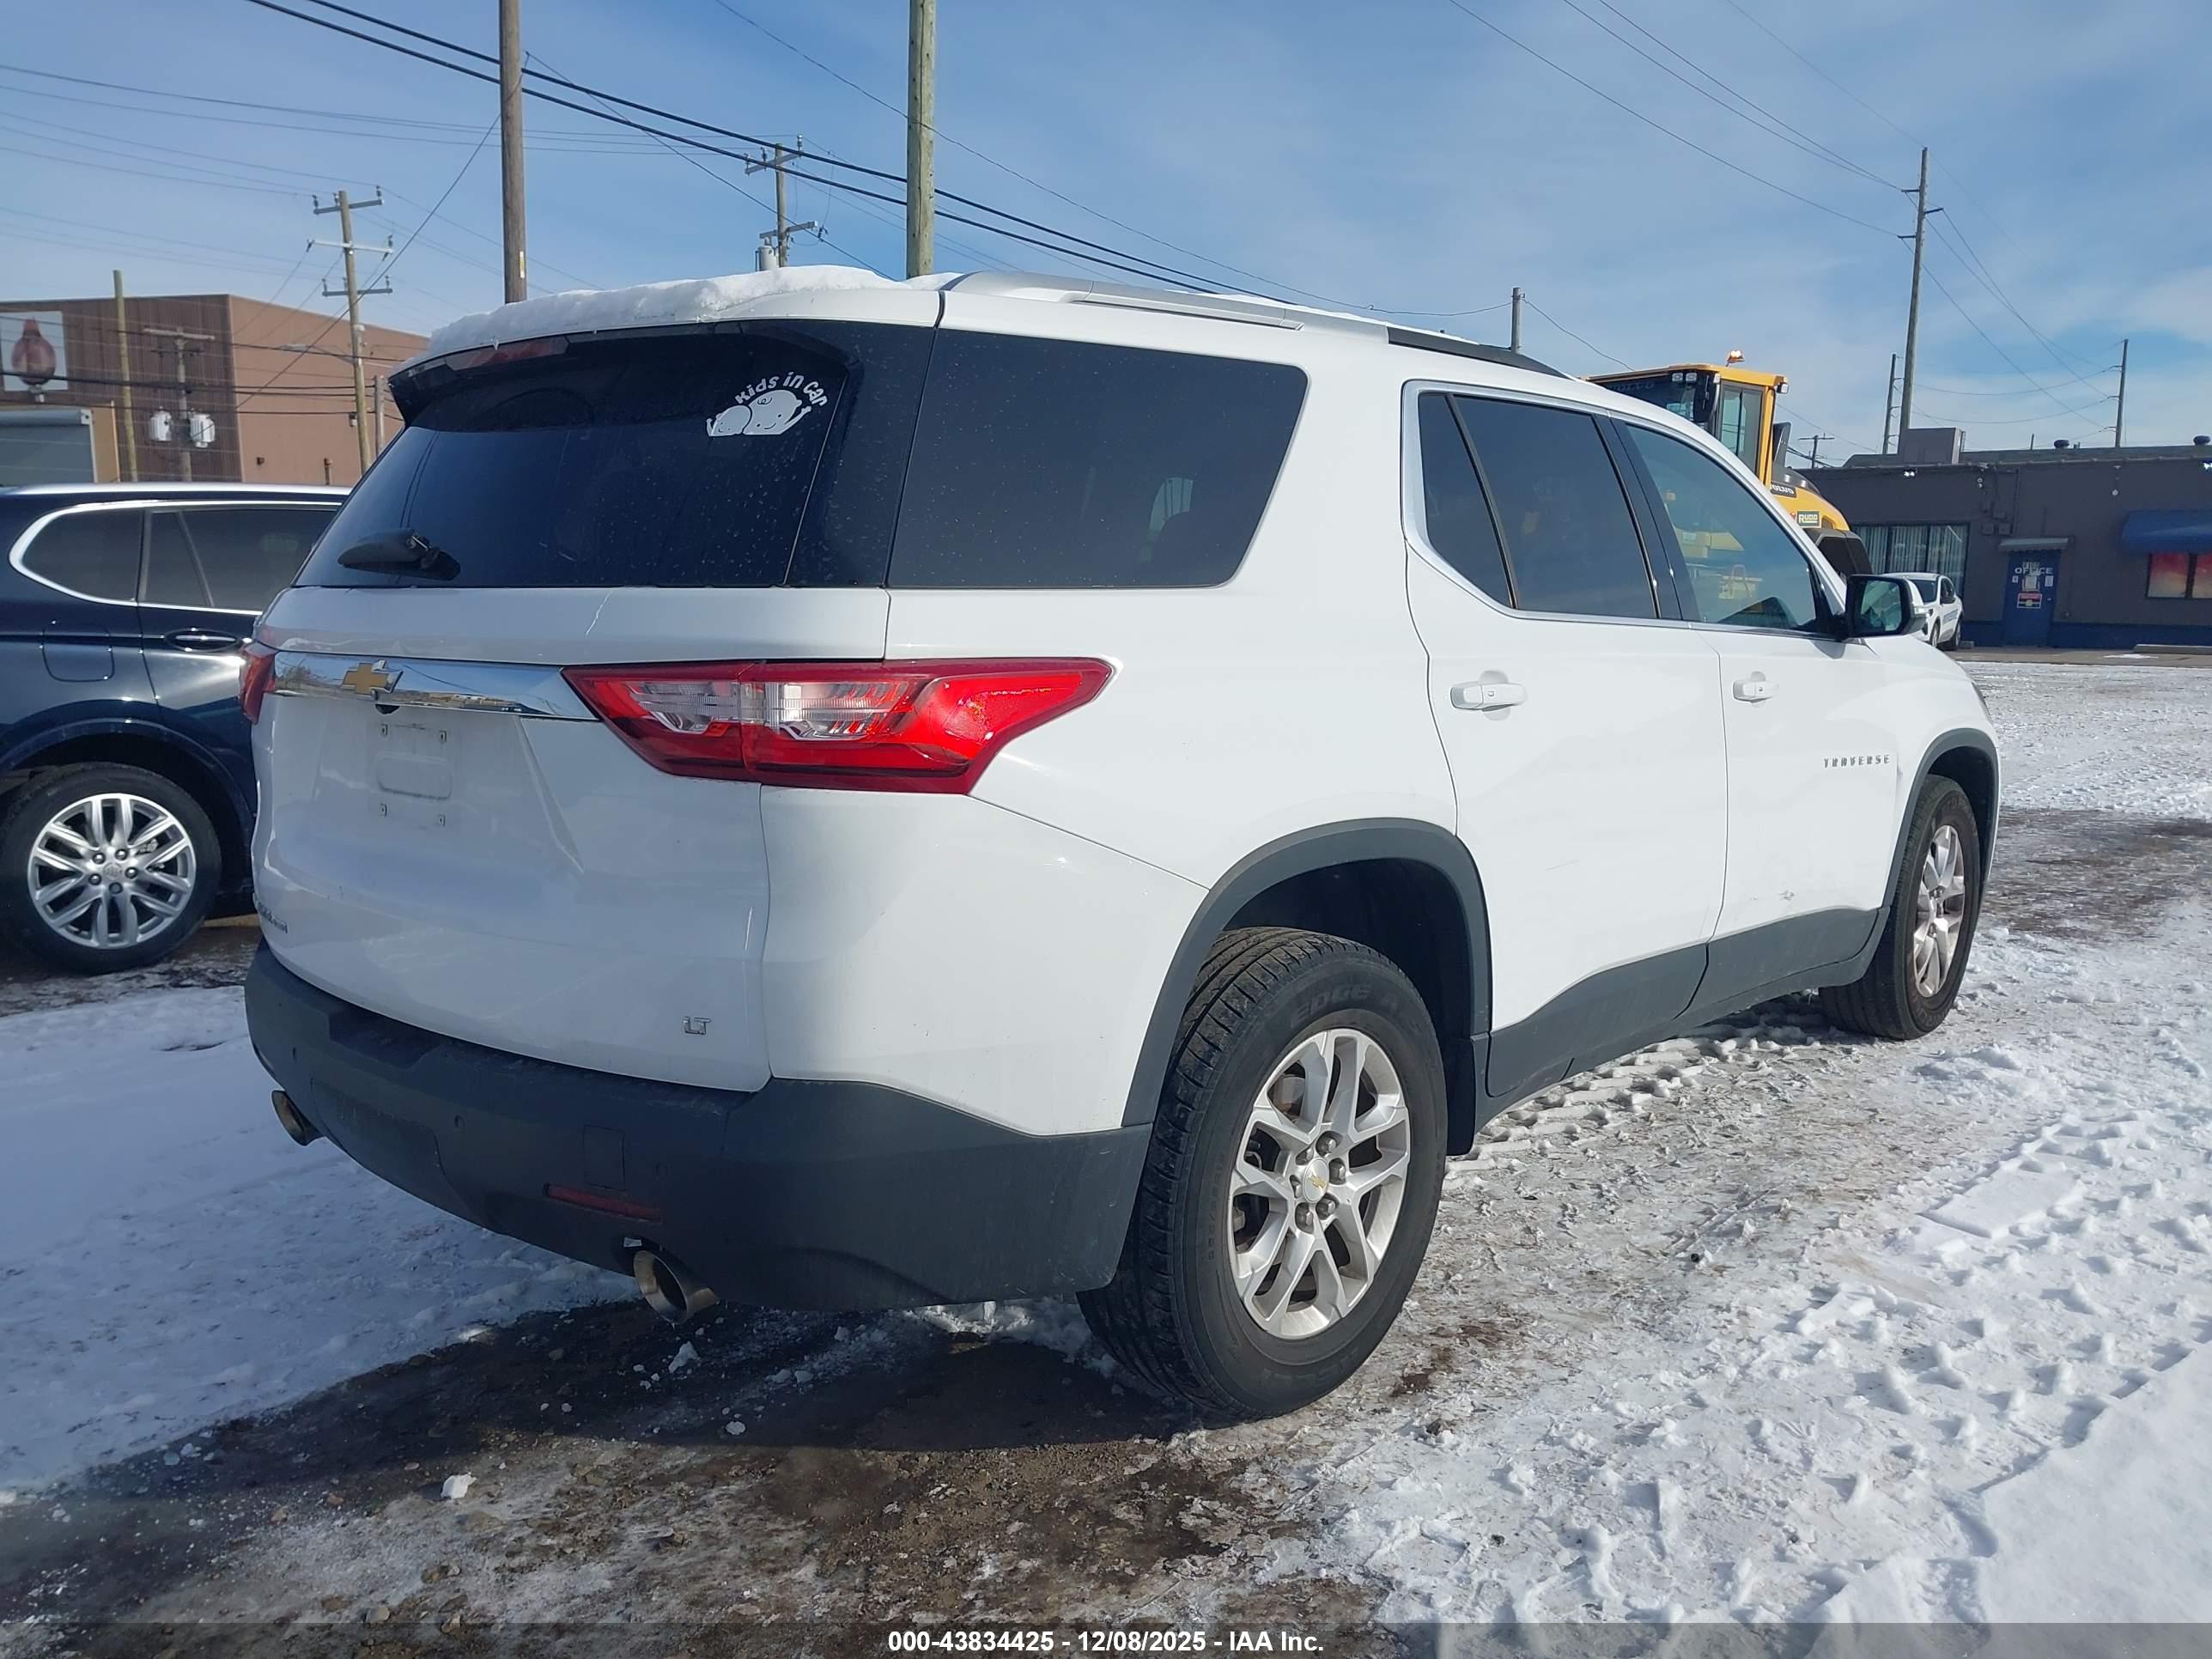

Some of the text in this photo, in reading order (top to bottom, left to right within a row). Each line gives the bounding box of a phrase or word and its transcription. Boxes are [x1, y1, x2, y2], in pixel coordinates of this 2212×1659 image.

[783, 371, 805, 389] in
[1771, 484, 1795, 495] OLVO
[1798, 514, 1819, 524] RUDD
[1823, 755, 1890, 769] TRAVERSE
[684, 1016, 712, 1036] LT
